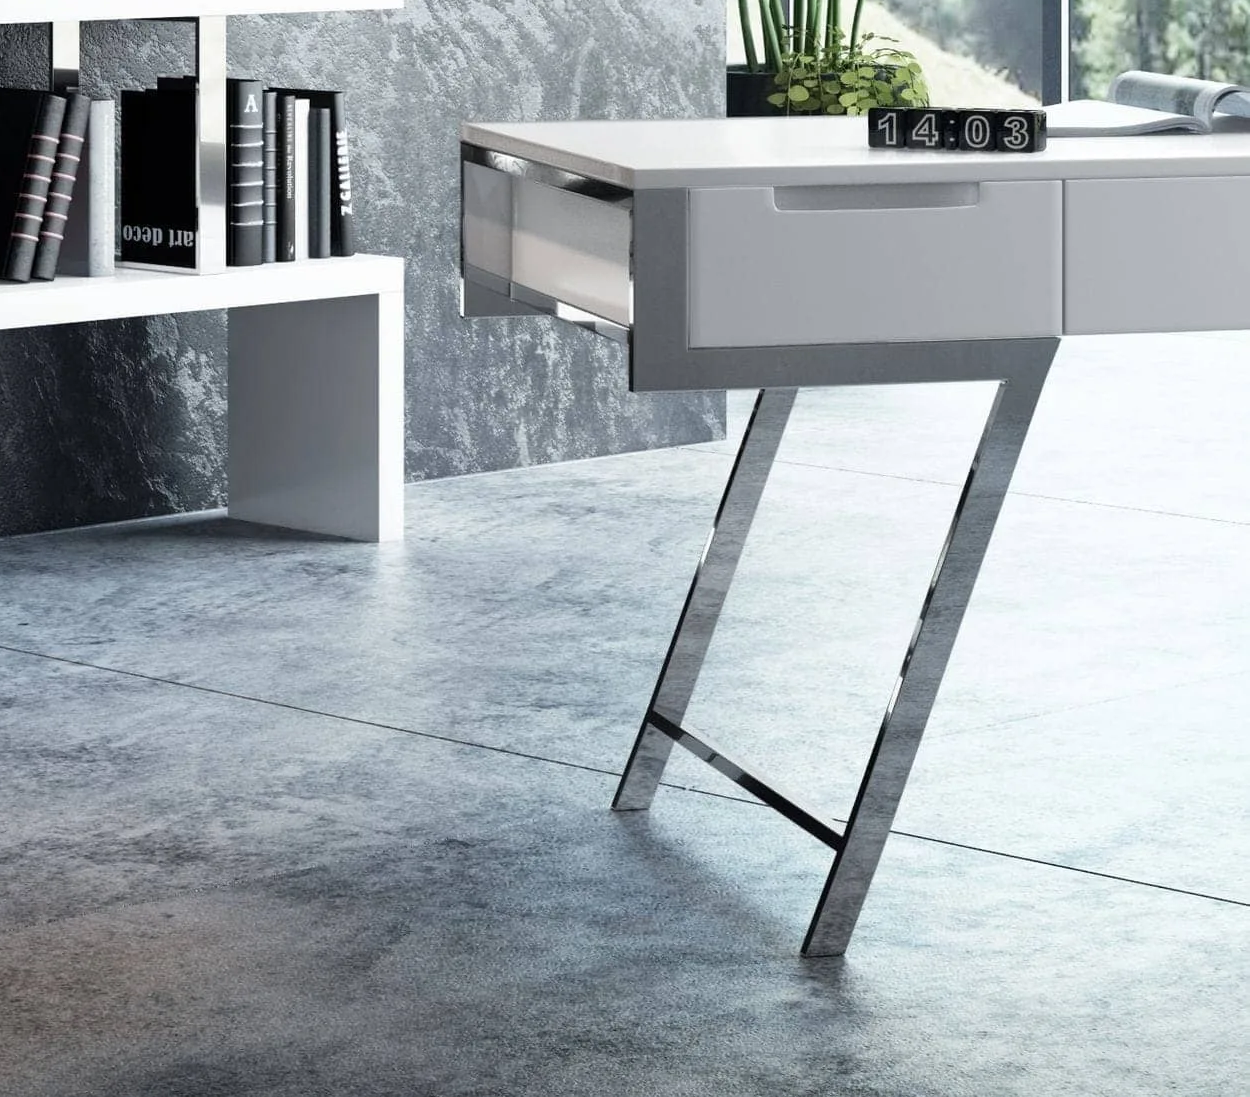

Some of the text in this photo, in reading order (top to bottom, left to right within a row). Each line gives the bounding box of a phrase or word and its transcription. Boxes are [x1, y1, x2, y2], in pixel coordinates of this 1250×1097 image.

[244, 94, 258, 112] A
[878, 112, 1029, 149] 14:03
[123, 225, 194, 247] art deco
